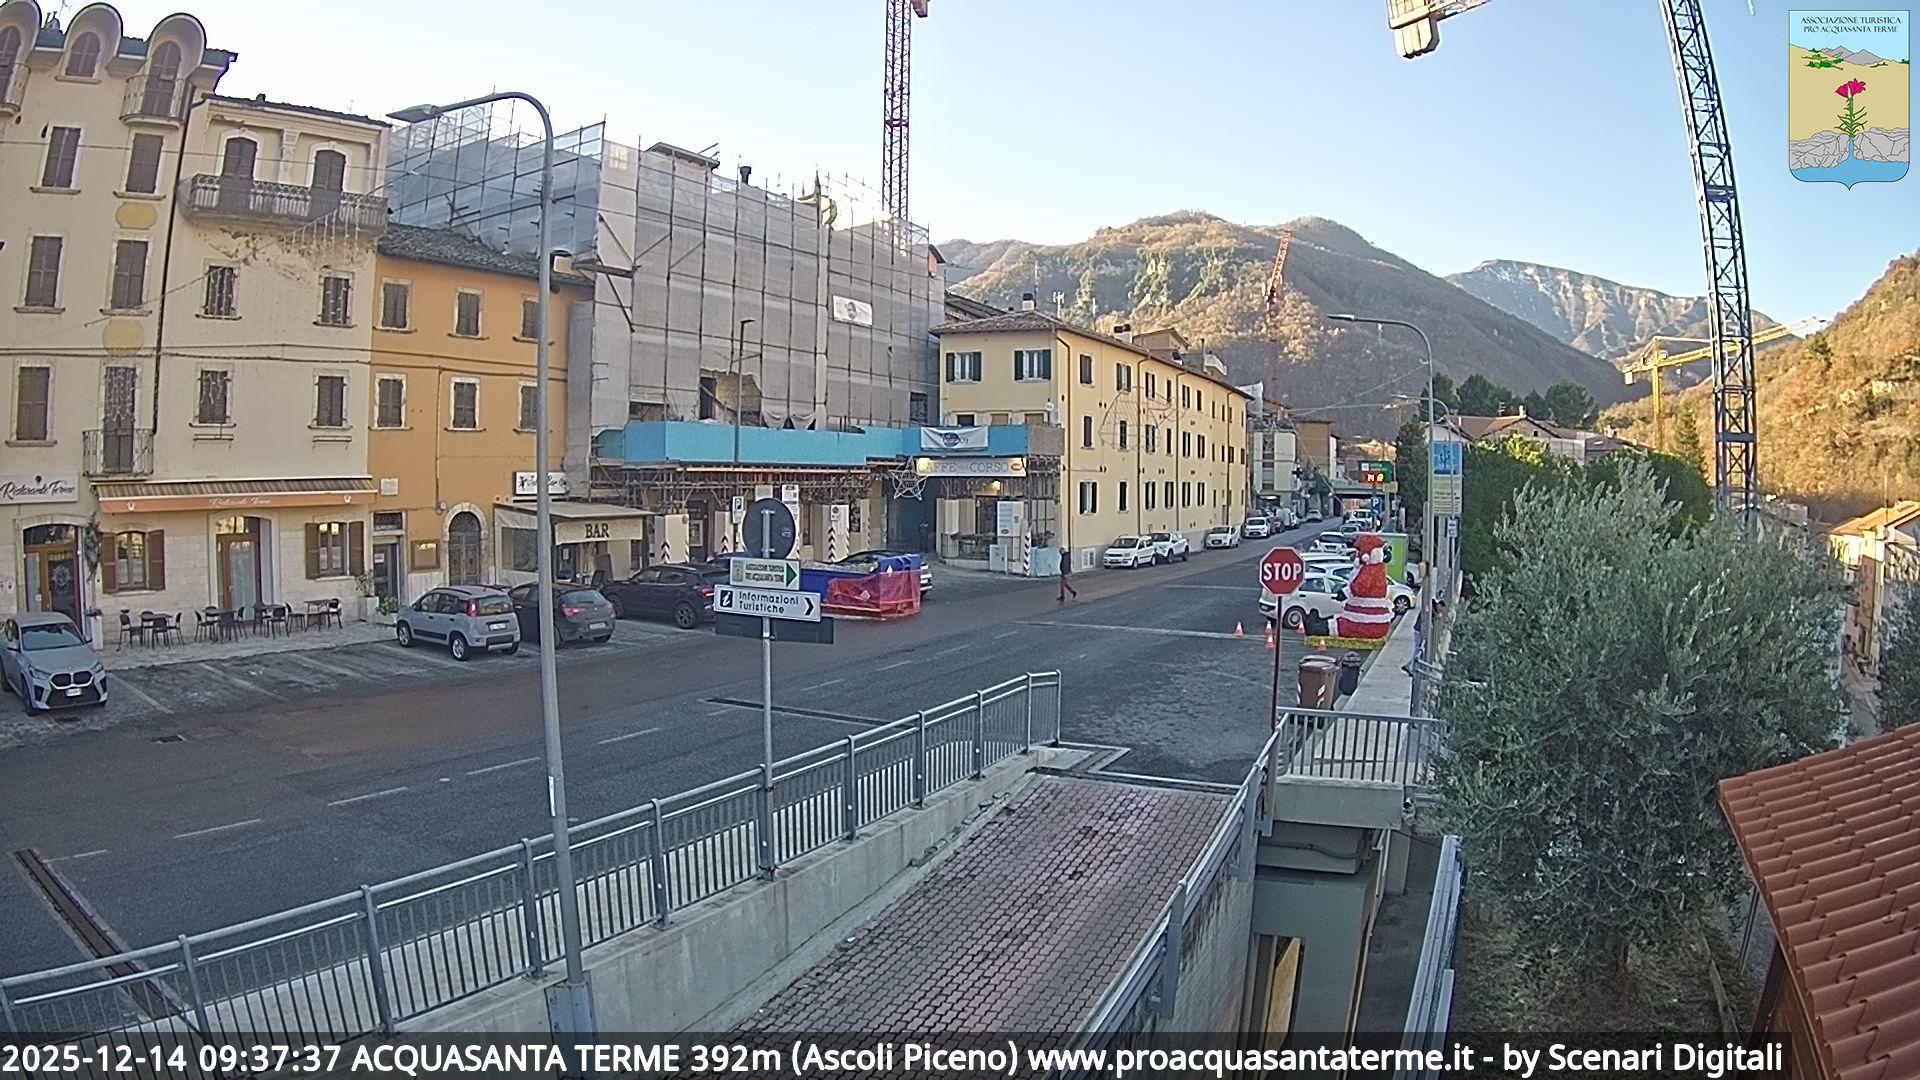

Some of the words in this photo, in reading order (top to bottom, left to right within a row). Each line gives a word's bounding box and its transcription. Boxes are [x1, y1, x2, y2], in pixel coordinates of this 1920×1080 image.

[970, 461, 1009, 473] CORSO
[585, 523, 609, 539] BAR
[1263, 562, 1302, 581] STOP
[739, 592, 799, 605] Informazioni
[739, 602, 785, 613] Turistiche
